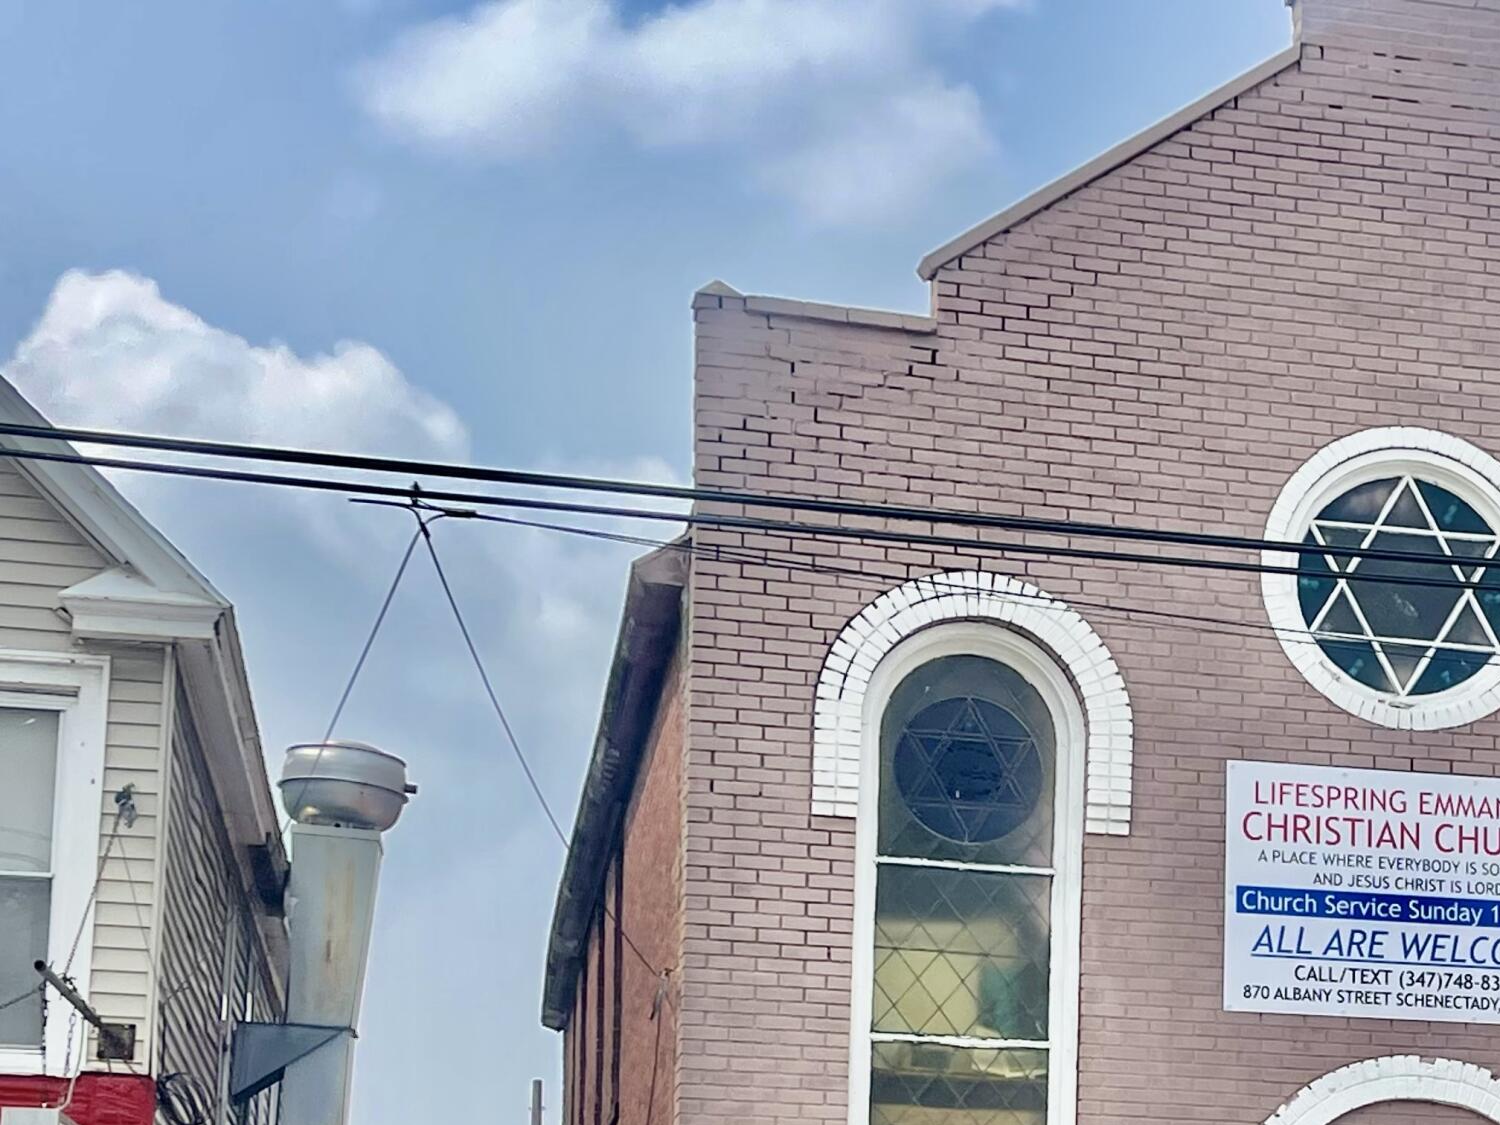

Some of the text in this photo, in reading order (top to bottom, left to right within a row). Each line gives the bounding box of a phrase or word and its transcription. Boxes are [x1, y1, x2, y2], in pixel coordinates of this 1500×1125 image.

[1255, 780, 1407, 814] LIFESPRING
[1242, 811, 1420, 851] CHRISTIAN
[1258, 850, 1268, 862] A
[1272, 851, 1317, 866] PLACE
[1322, 853, 1373, 869] WHERE
[1378, 856, 1460, 875] EVERYBODY
[1466, 862, 1477, 875] IS
[1313, 873, 1343, 887] AND
[1347, 874, 1390, 890] JESUS
[1394, 877, 1445, 893] CHRIST
[1450, 881, 1462, 893] IS
[1242, 891, 1317, 914] Church
[1325, 895, 1401, 918] Service
[1409, 900, 1483, 926] Sunday
[1252, 925, 1313, 955] ALL
[1323, 929, 1388, 959] ARE
[1294, 965, 1393, 986] CALL/TEXT
[1243, 985, 1270, 1000] 870
[1274, 987, 1332, 1004] ALBANY
[1337, 990, 1391, 1006] STREET
